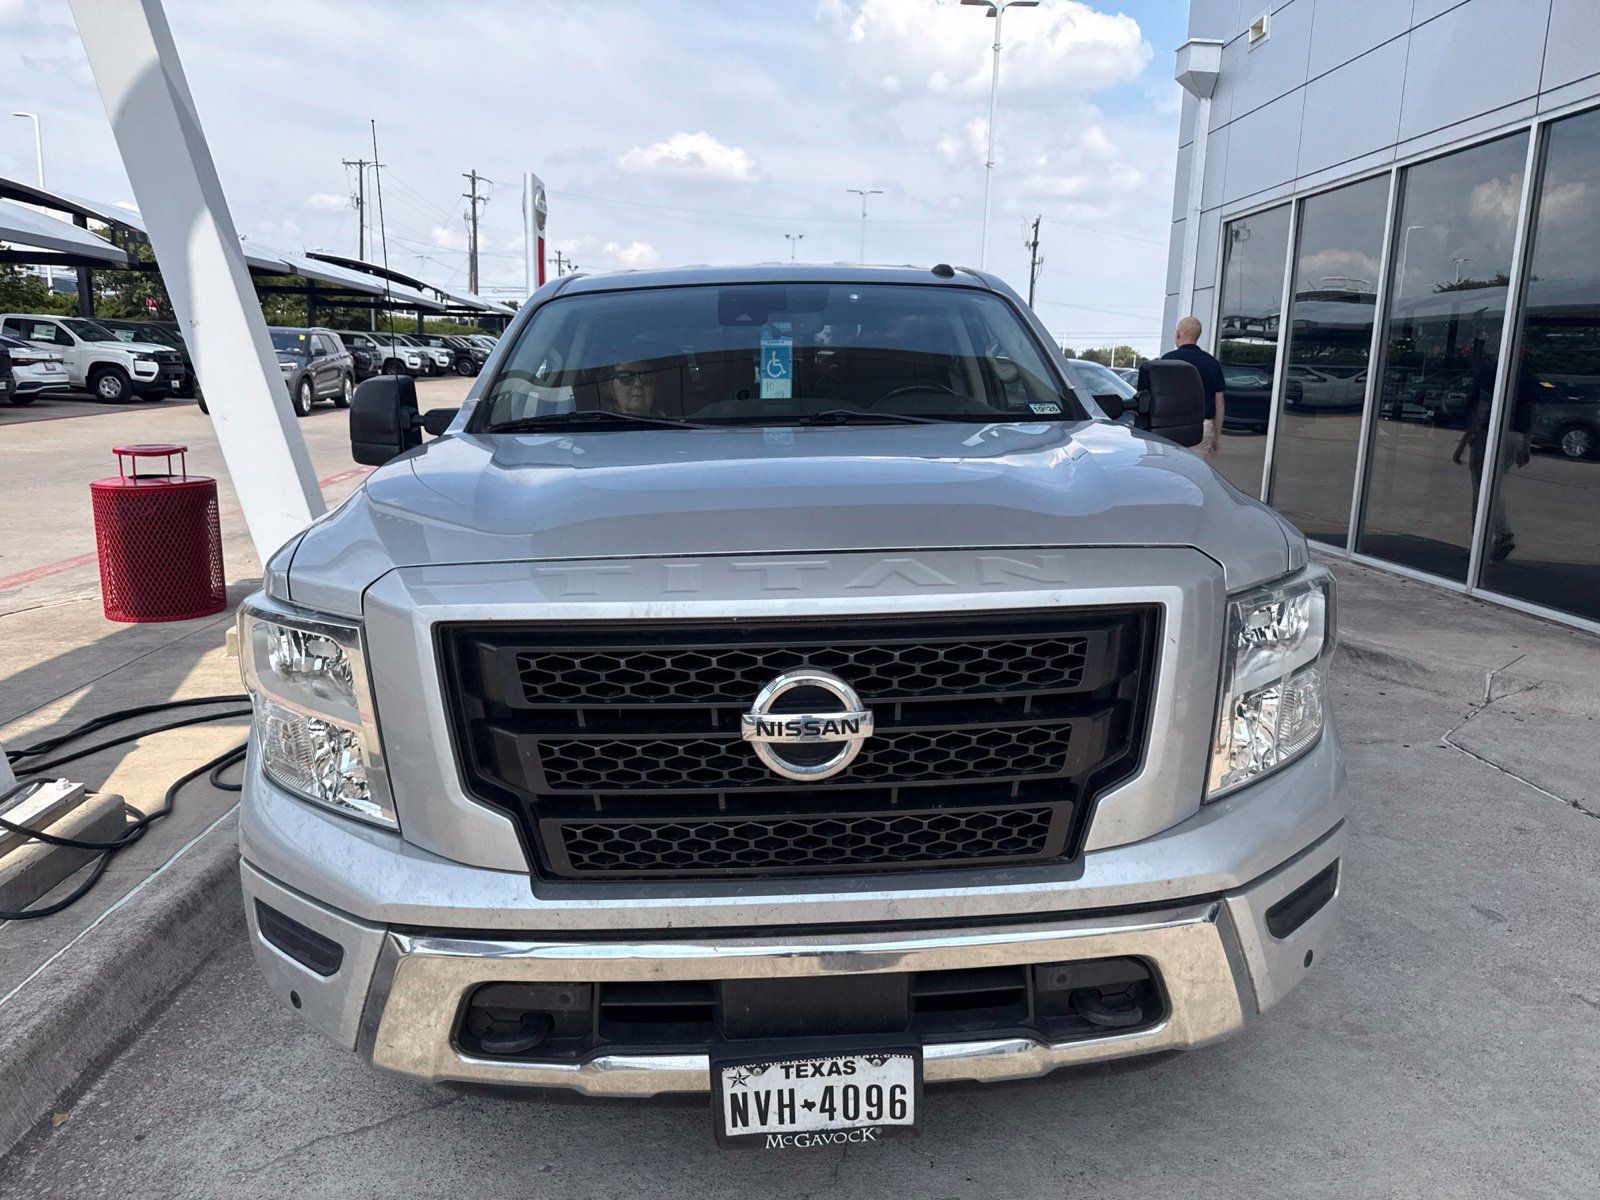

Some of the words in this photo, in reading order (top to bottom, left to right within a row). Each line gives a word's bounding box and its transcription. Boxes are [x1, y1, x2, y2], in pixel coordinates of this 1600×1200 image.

[532, 555, 1071, 596] TITAN
[756, 718, 860, 737] NISSAN
[780, 1060, 857, 1080] TEXAS
[730, 1088, 796, 1128] NVH
[819, 1084, 907, 1121] 4096
